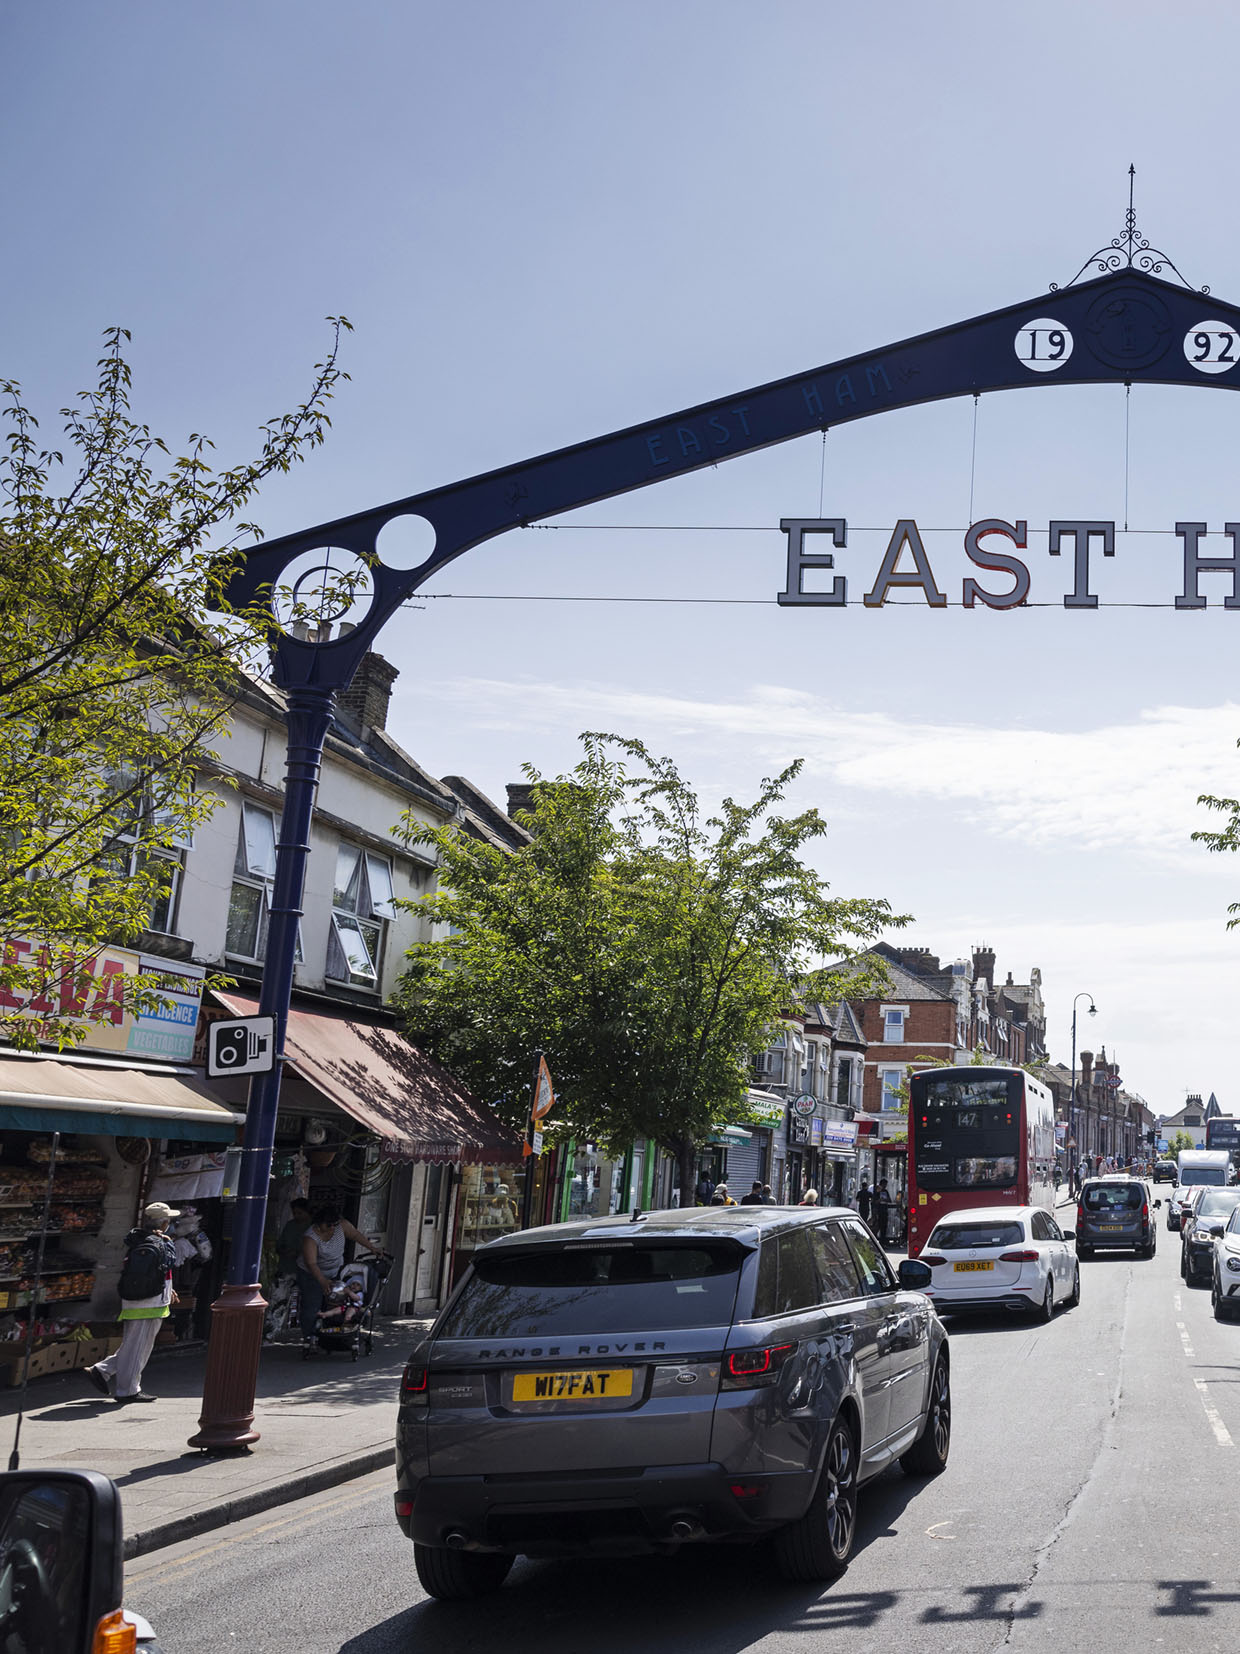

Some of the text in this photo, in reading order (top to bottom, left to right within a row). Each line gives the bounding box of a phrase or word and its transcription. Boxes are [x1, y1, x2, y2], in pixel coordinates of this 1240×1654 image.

[1029, 330, 1234, 361] 19 92
[647, 364, 892, 466] EAST HAM
[777, 518, 1115, 609] EAST
[797, 1100, 813, 1108] PAAN
[958, 1112, 977, 1126] 147
[956, 1262, 991, 1272] EU69 XET
[479, 1341, 666, 1359] RANGE ROVER
